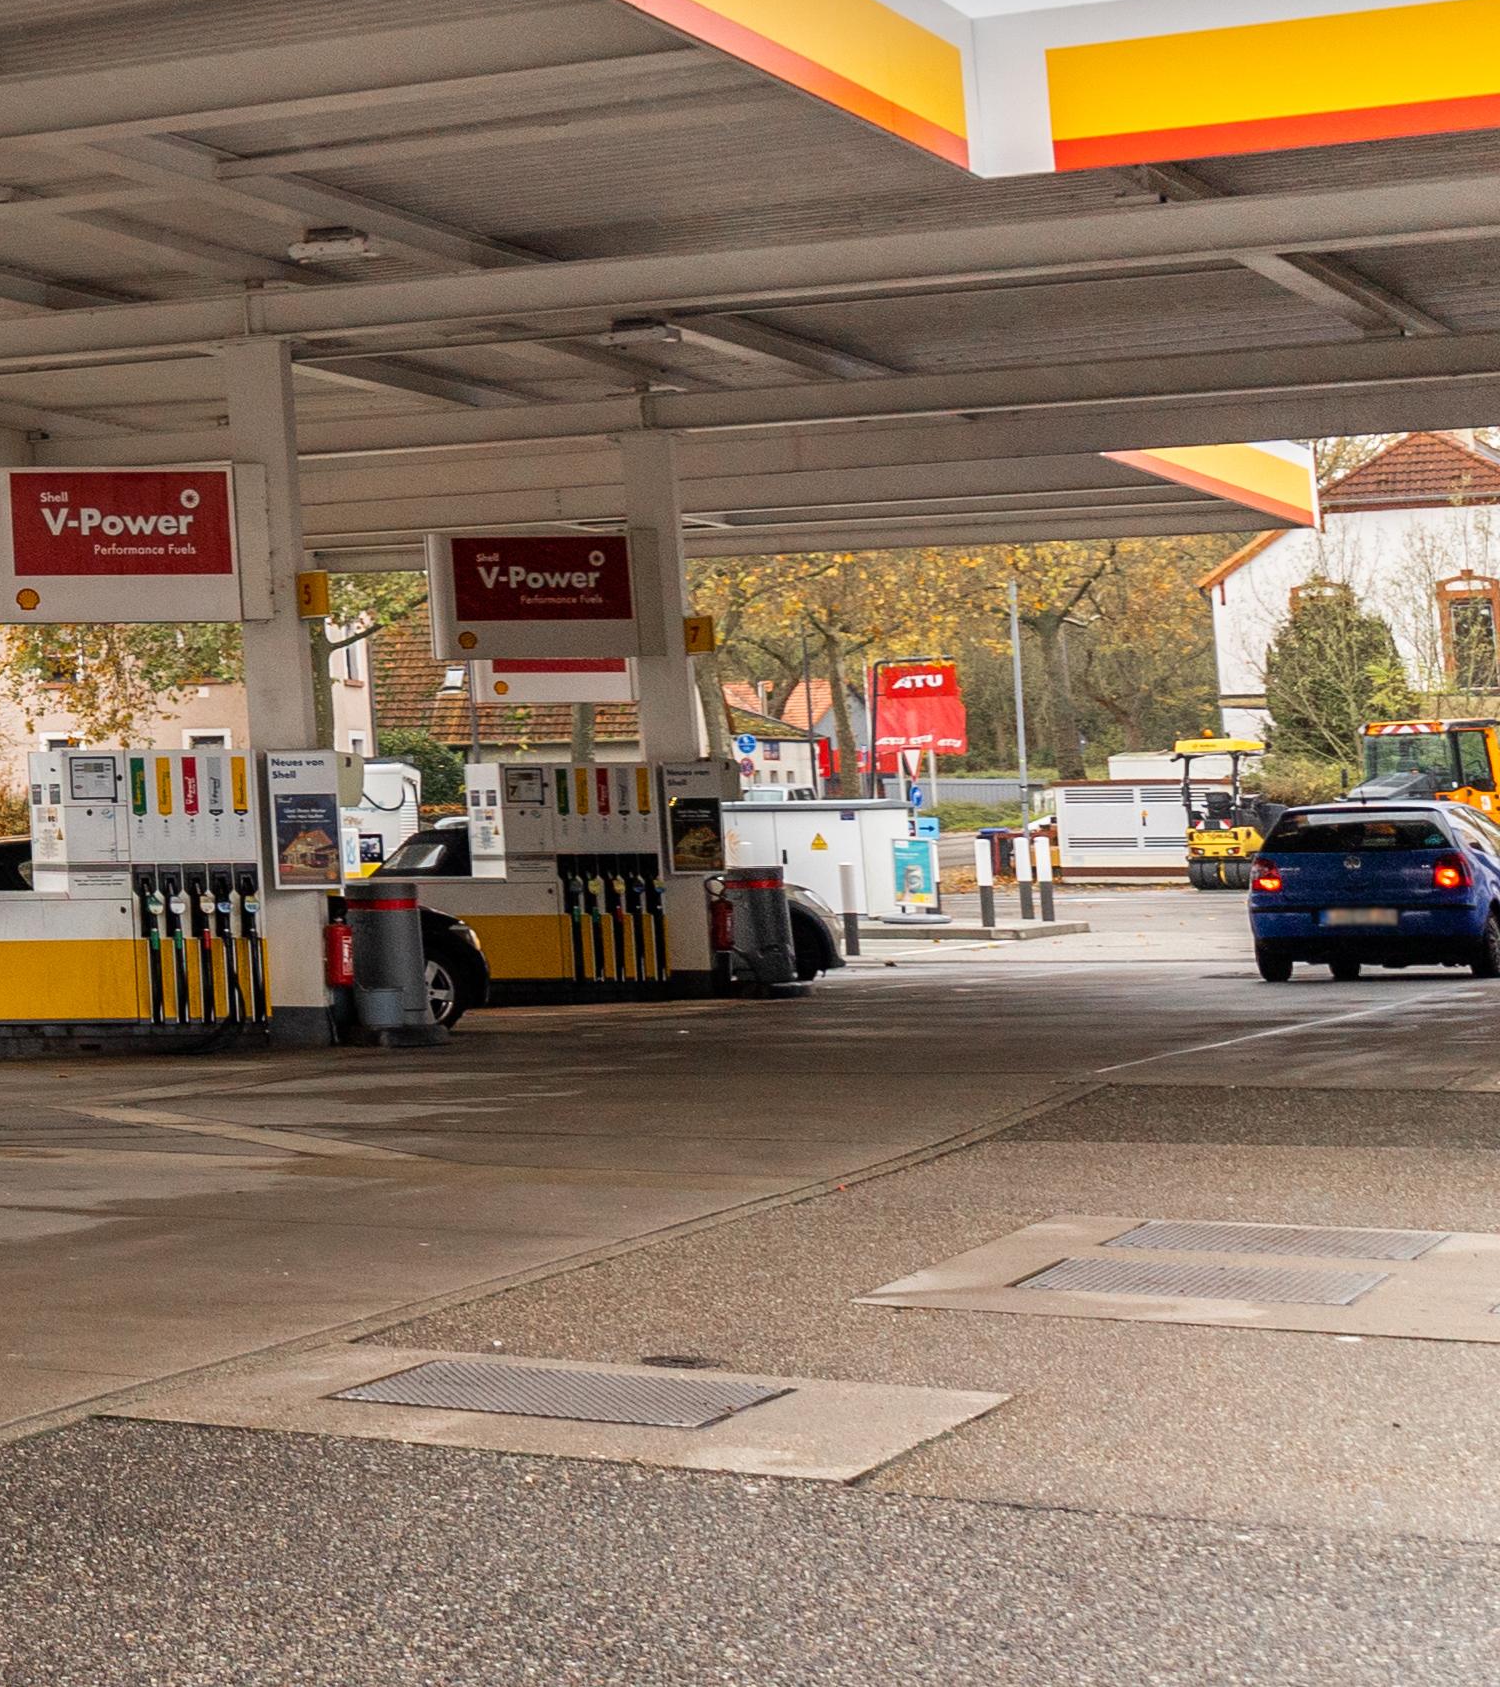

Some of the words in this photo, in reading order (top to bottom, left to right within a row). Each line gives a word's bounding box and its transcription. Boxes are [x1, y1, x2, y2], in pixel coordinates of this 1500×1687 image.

[40, 492, 69, 503] Shell
[41, 508, 194, 536] V-Power
[94, 544, 164, 555] Performance
[168, 543, 196, 555] Fuels
[476, 553, 500, 562] Shell
[477, 566, 600, 589] V-Power
[304, 584, 312, 605] 5
[520, 595, 576, 605] Performance
[580, 594, 603, 604] Fuels
[691, 626, 700, 644] 7
[891, 674, 943, 689] ATU
[271, 758, 303, 767] Neues
[306, 759, 325, 767] von
[272, 770, 297, 779] Shell
